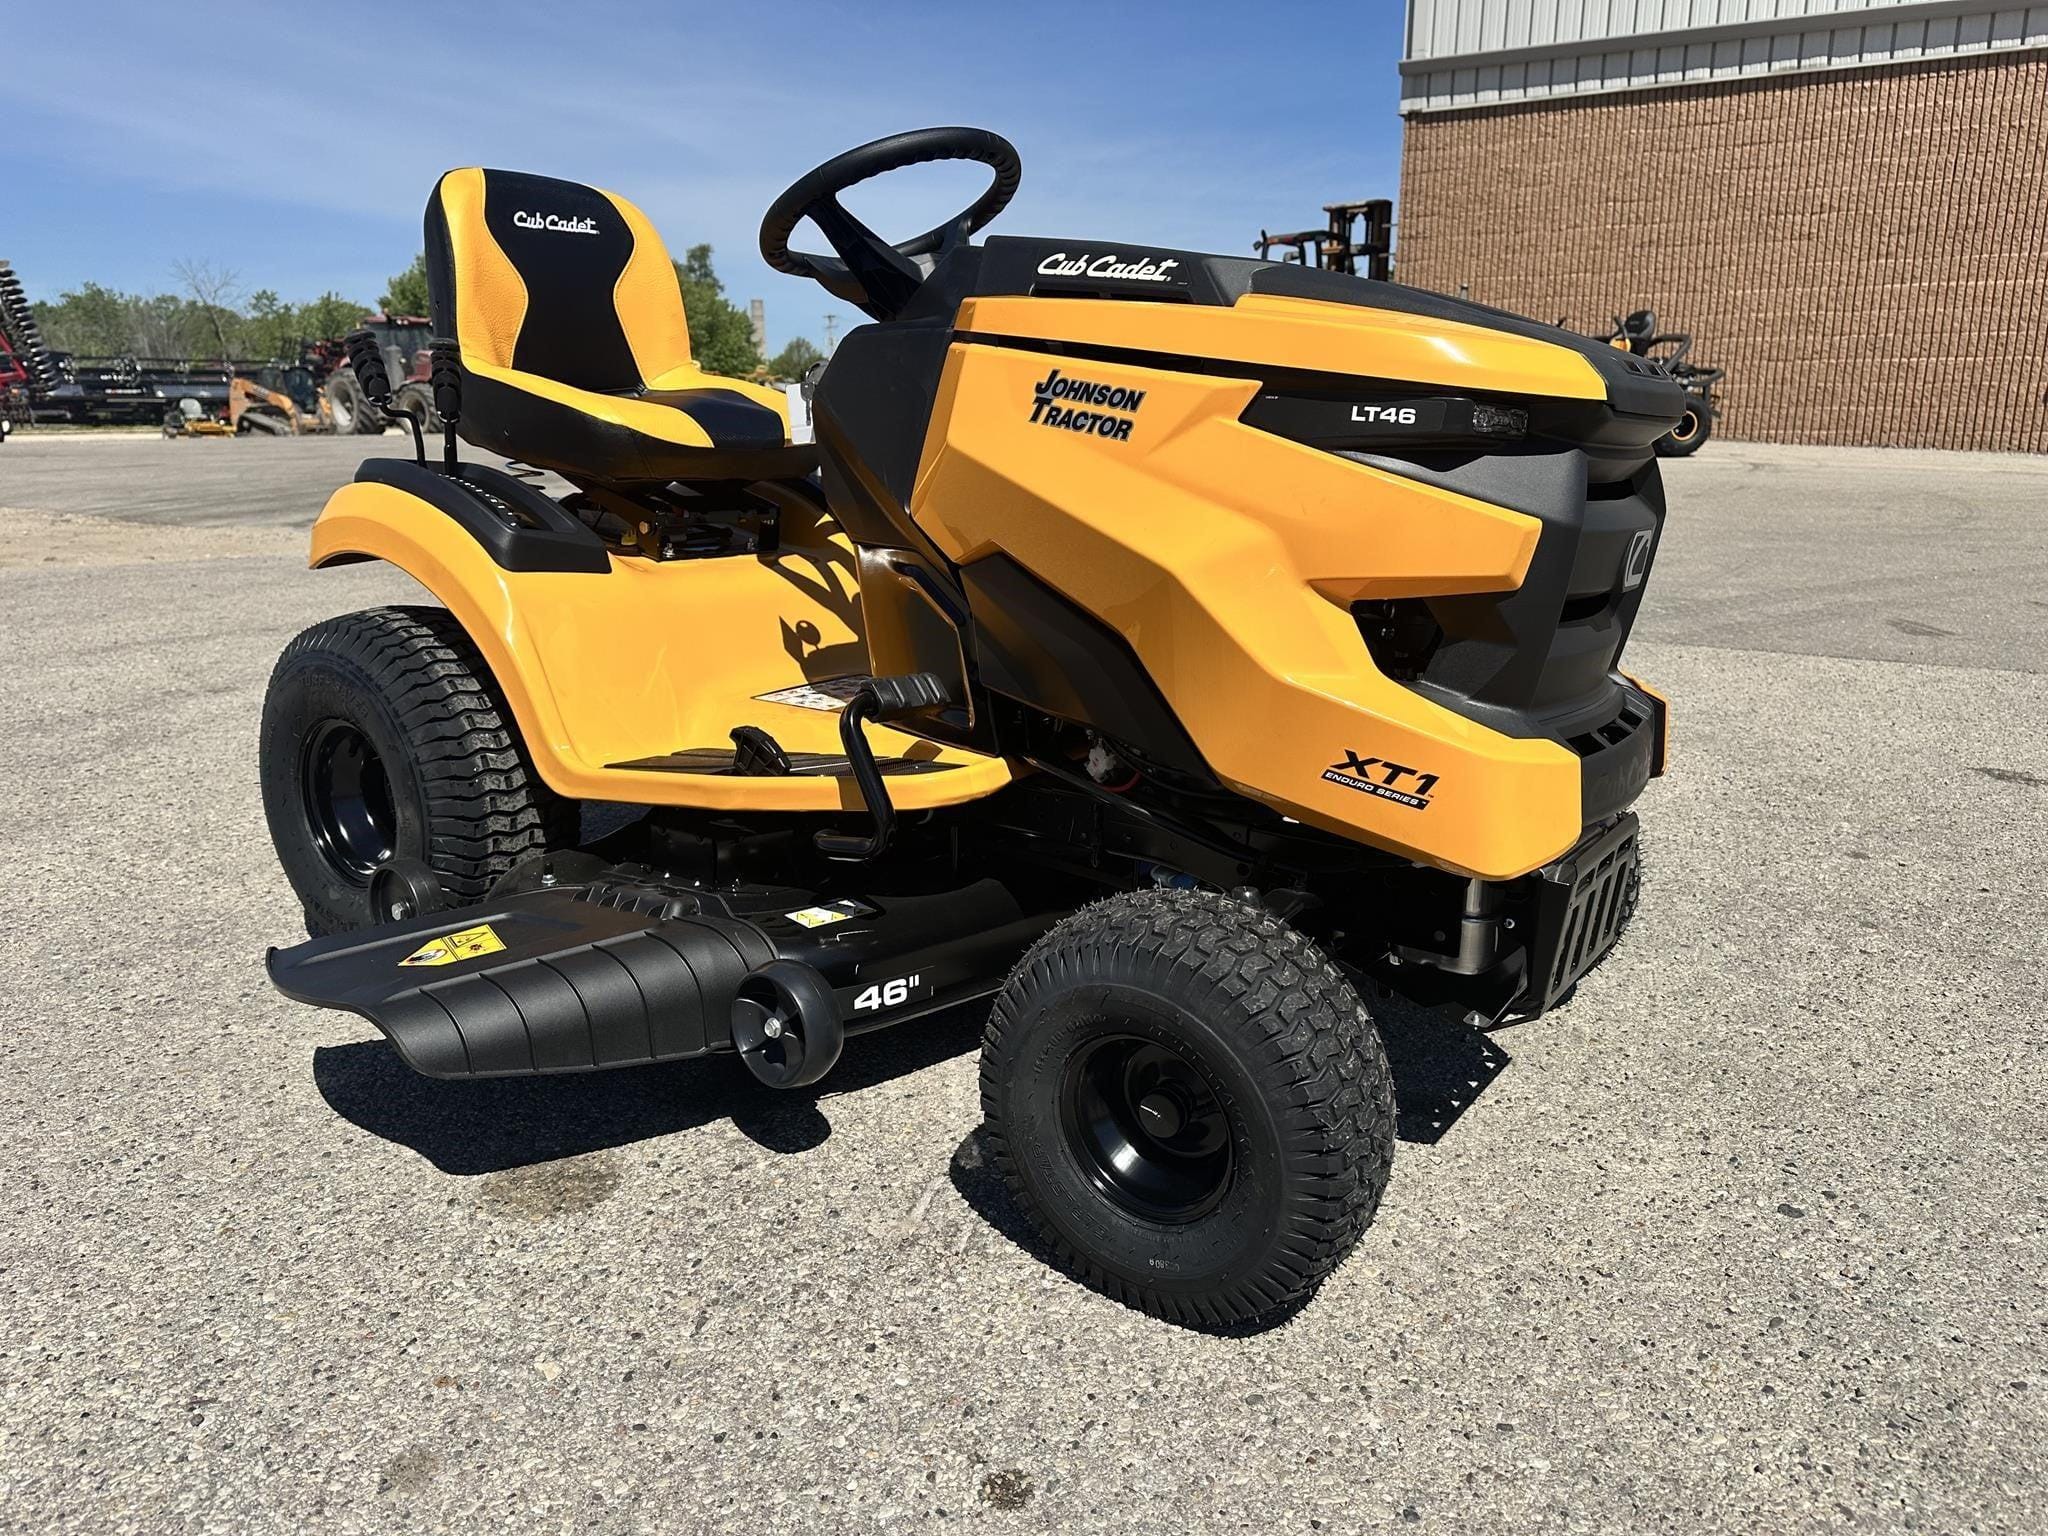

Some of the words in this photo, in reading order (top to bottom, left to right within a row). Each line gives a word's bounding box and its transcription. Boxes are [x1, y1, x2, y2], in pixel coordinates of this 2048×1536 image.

[513, 210, 545, 229] Cub
[545, 214, 600, 235] Cadet
[1037, 252, 1090, 276] Cub
[1086, 255, 1179, 282] Cadet
[1034, 368, 1147, 413] JOHNSON
[1028, 396, 1134, 442] TRACTOR
[1351, 405, 1417, 425] LT46
[1324, 771, 1375, 791] ENDURO
[1376, 788, 1420, 806] SERIES
[1329, 748, 1441, 796] XT1
[854, 974, 920, 1010] 46"
